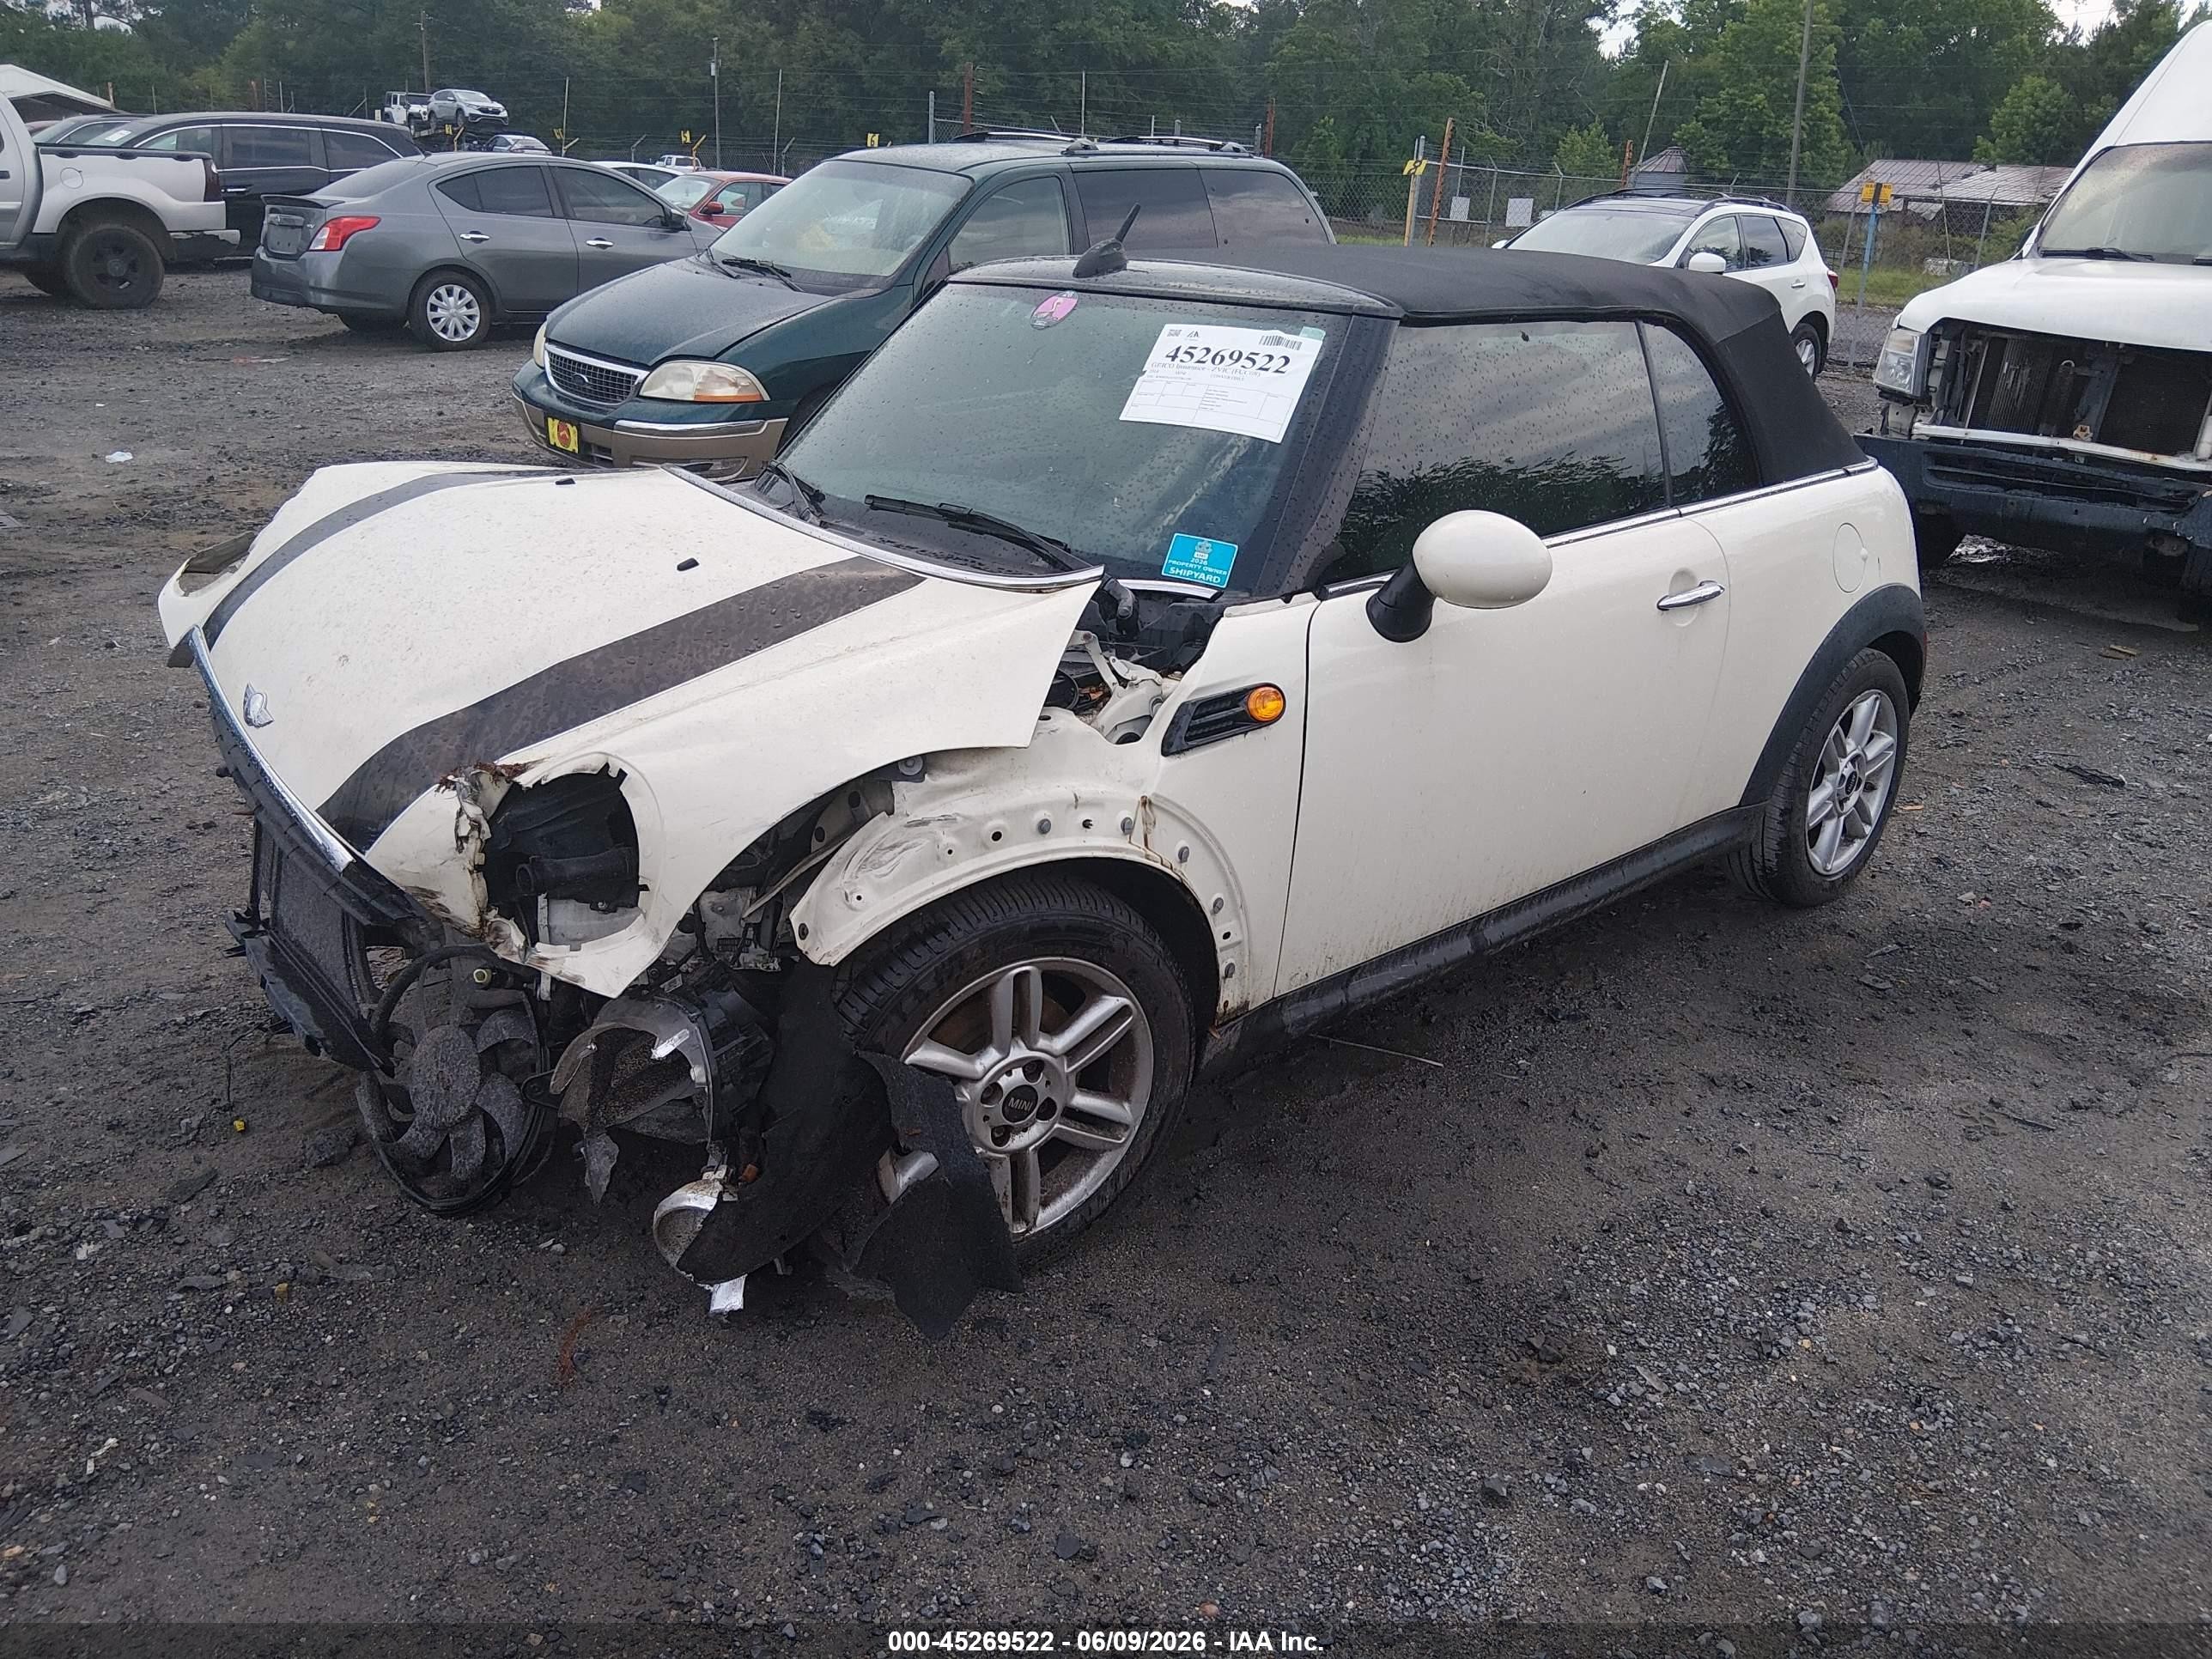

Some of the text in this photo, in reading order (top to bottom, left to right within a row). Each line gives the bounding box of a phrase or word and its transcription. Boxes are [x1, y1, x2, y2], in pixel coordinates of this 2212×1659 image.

[1165, 345, 1291, 374] 45269522
[1168, 559, 1228, 575] PROPERTY OWNER
[1190, 557, 1208, 566] 2026
[1169, 567, 1221, 584] SHIPYARD
[1008, 1097, 1034, 1112] MINI
